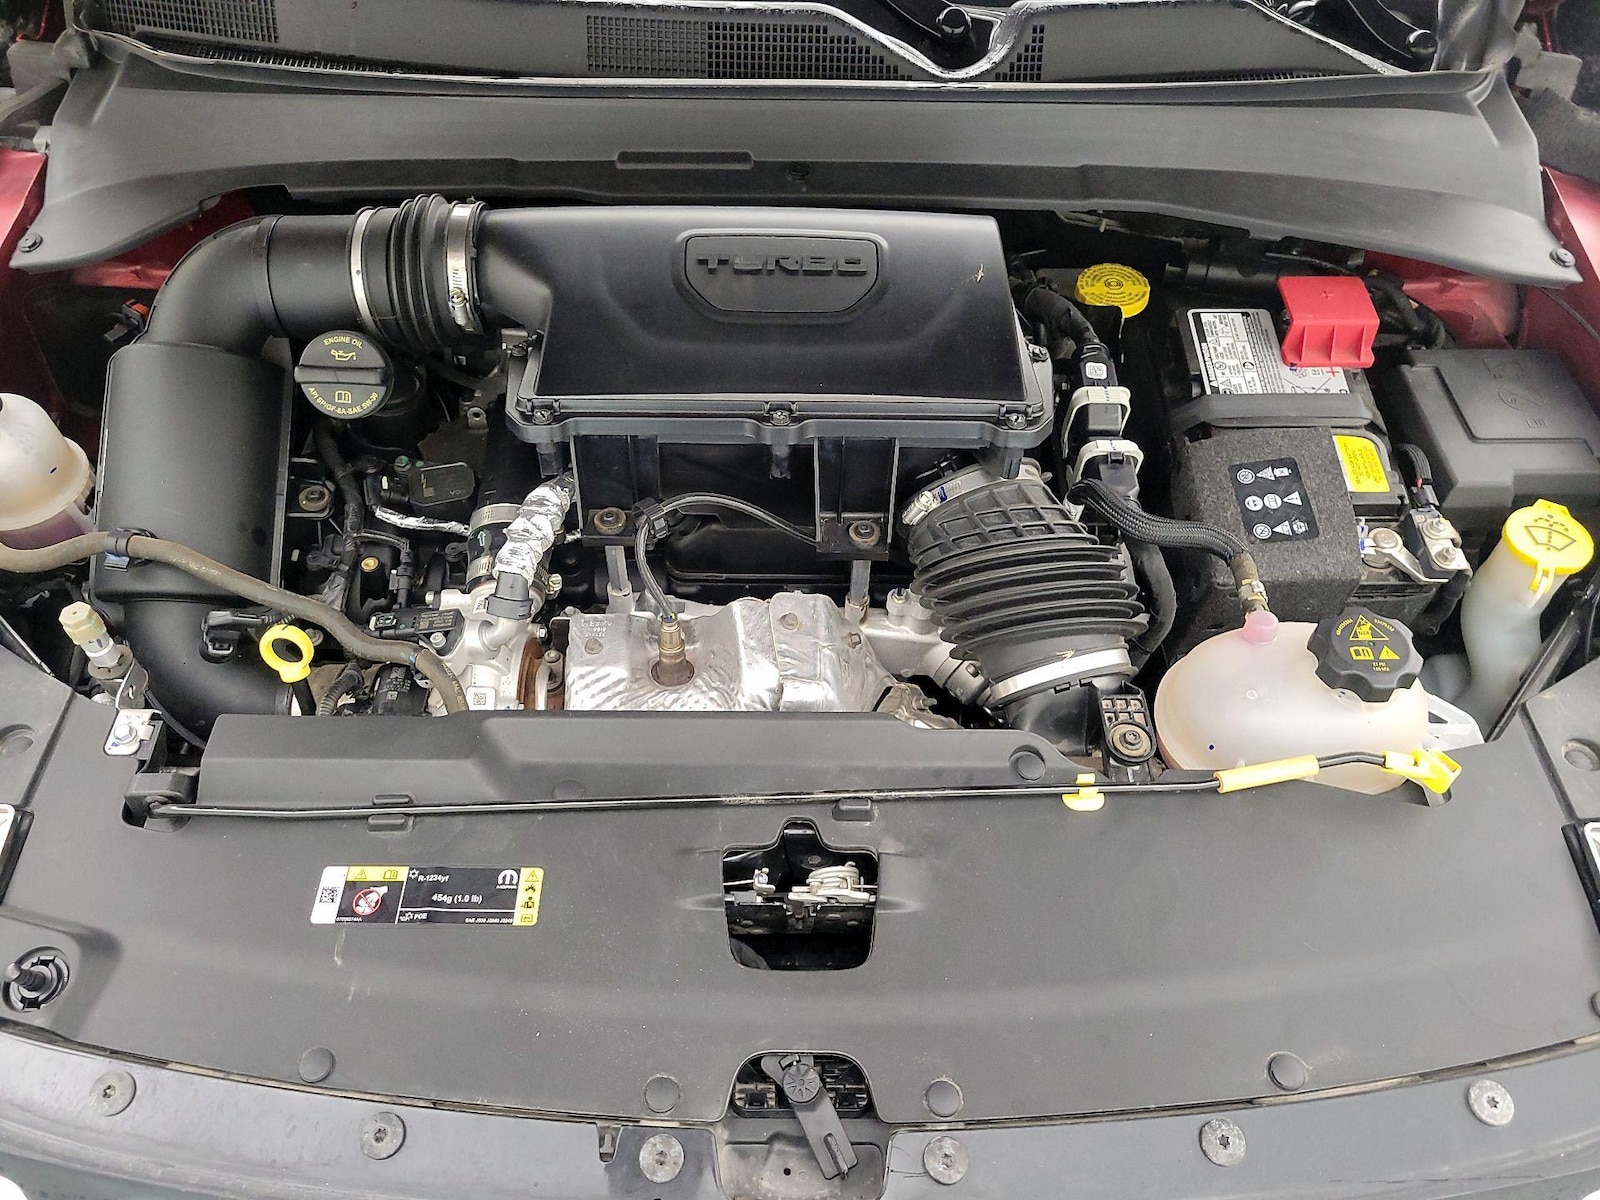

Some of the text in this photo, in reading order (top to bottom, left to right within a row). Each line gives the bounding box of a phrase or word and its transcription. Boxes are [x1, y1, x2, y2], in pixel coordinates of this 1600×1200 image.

[697, 253, 868, 277] TURBO
[323, 335, 364, 349] ENGINE OIL
[308, 387, 319, 399] API
[418, 874, 450, 883] R-1234yf
[431, 892, 483, 904] 454g (1.0 lb)
